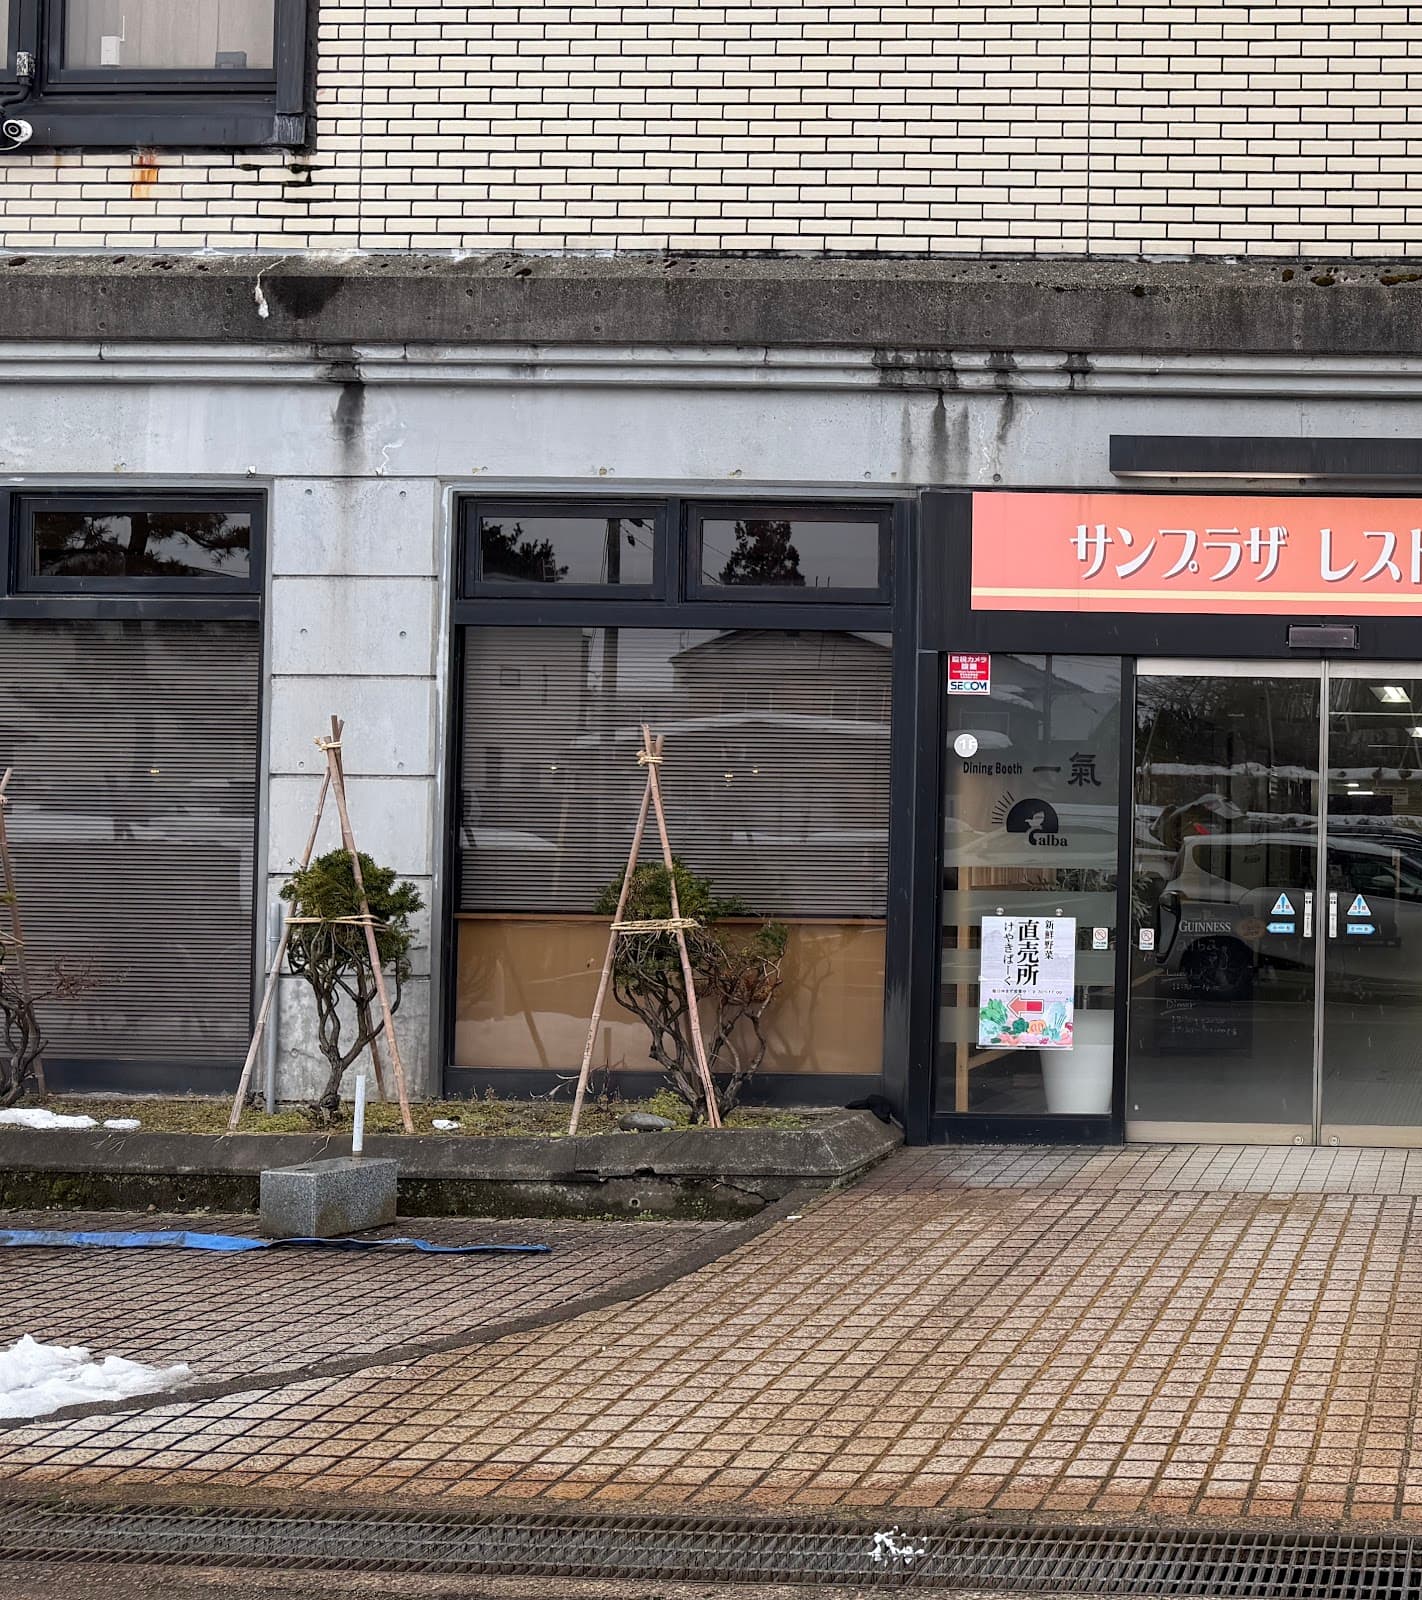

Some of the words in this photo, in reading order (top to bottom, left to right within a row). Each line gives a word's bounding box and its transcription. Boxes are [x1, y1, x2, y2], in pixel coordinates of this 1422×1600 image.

[1070, 523, 1288, 582] サンプラザ
[950, 681, 987, 690] SECOM
[963, 761, 993, 776] Dining
[995, 762, 1023, 775] Booth
[1178, 920, 1232, 934] GUINNESS
[1016, 919, 1040, 986] 直売所
